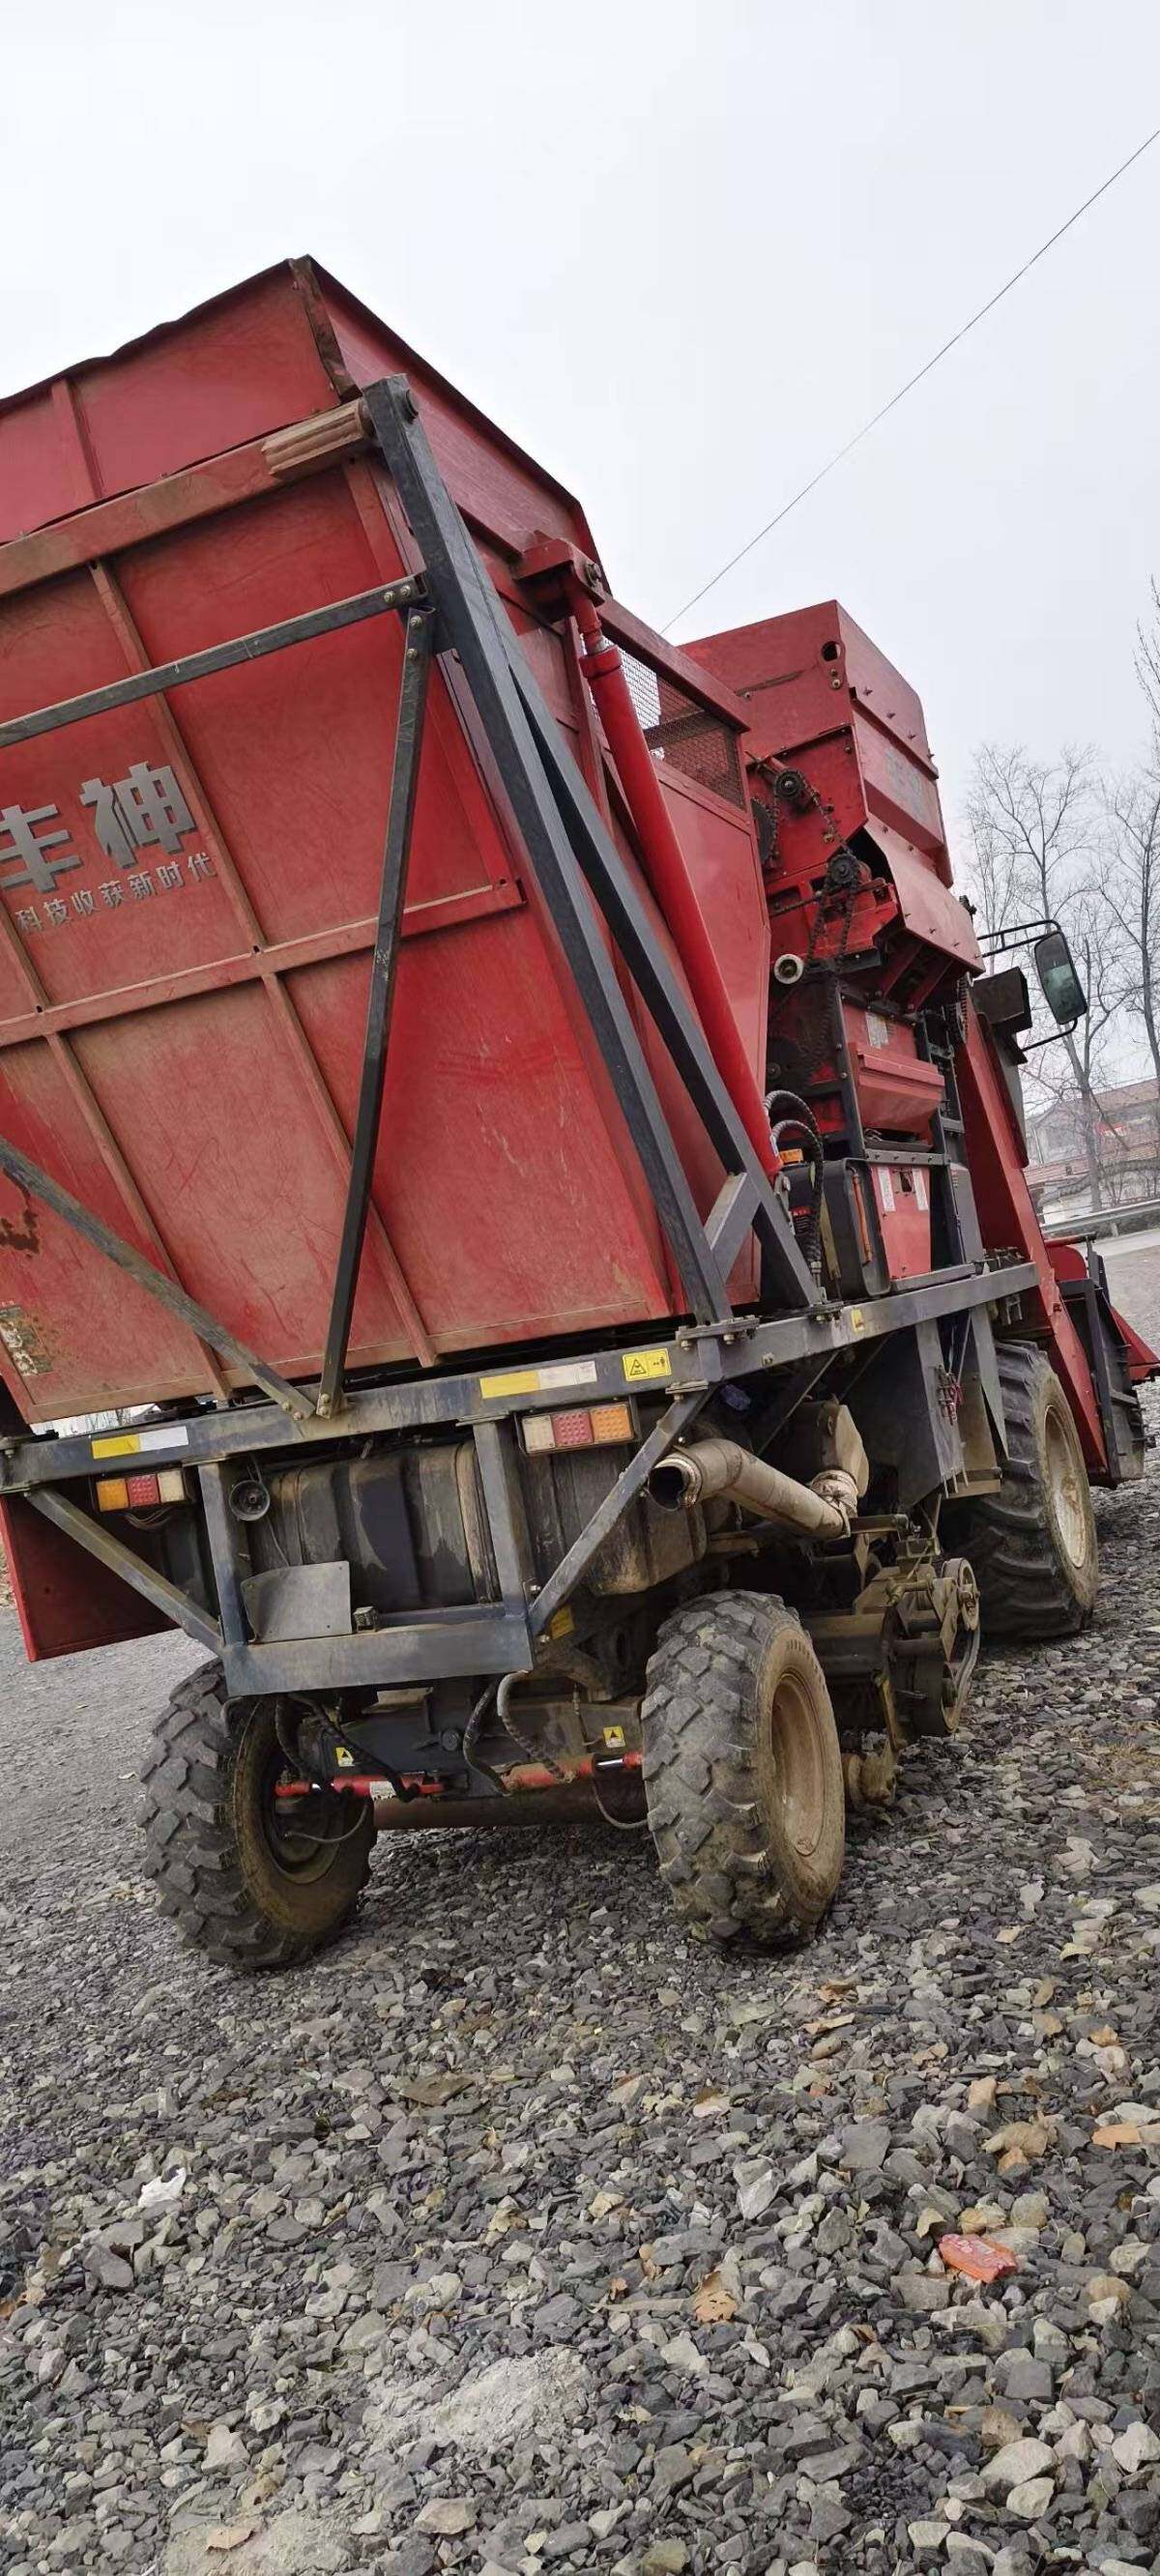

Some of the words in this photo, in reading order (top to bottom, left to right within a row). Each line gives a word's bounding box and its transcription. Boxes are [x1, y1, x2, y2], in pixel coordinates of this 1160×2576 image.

[0, 761, 196, 893] 丰神
[14, 852, 217, 931] 科技收获新时代
